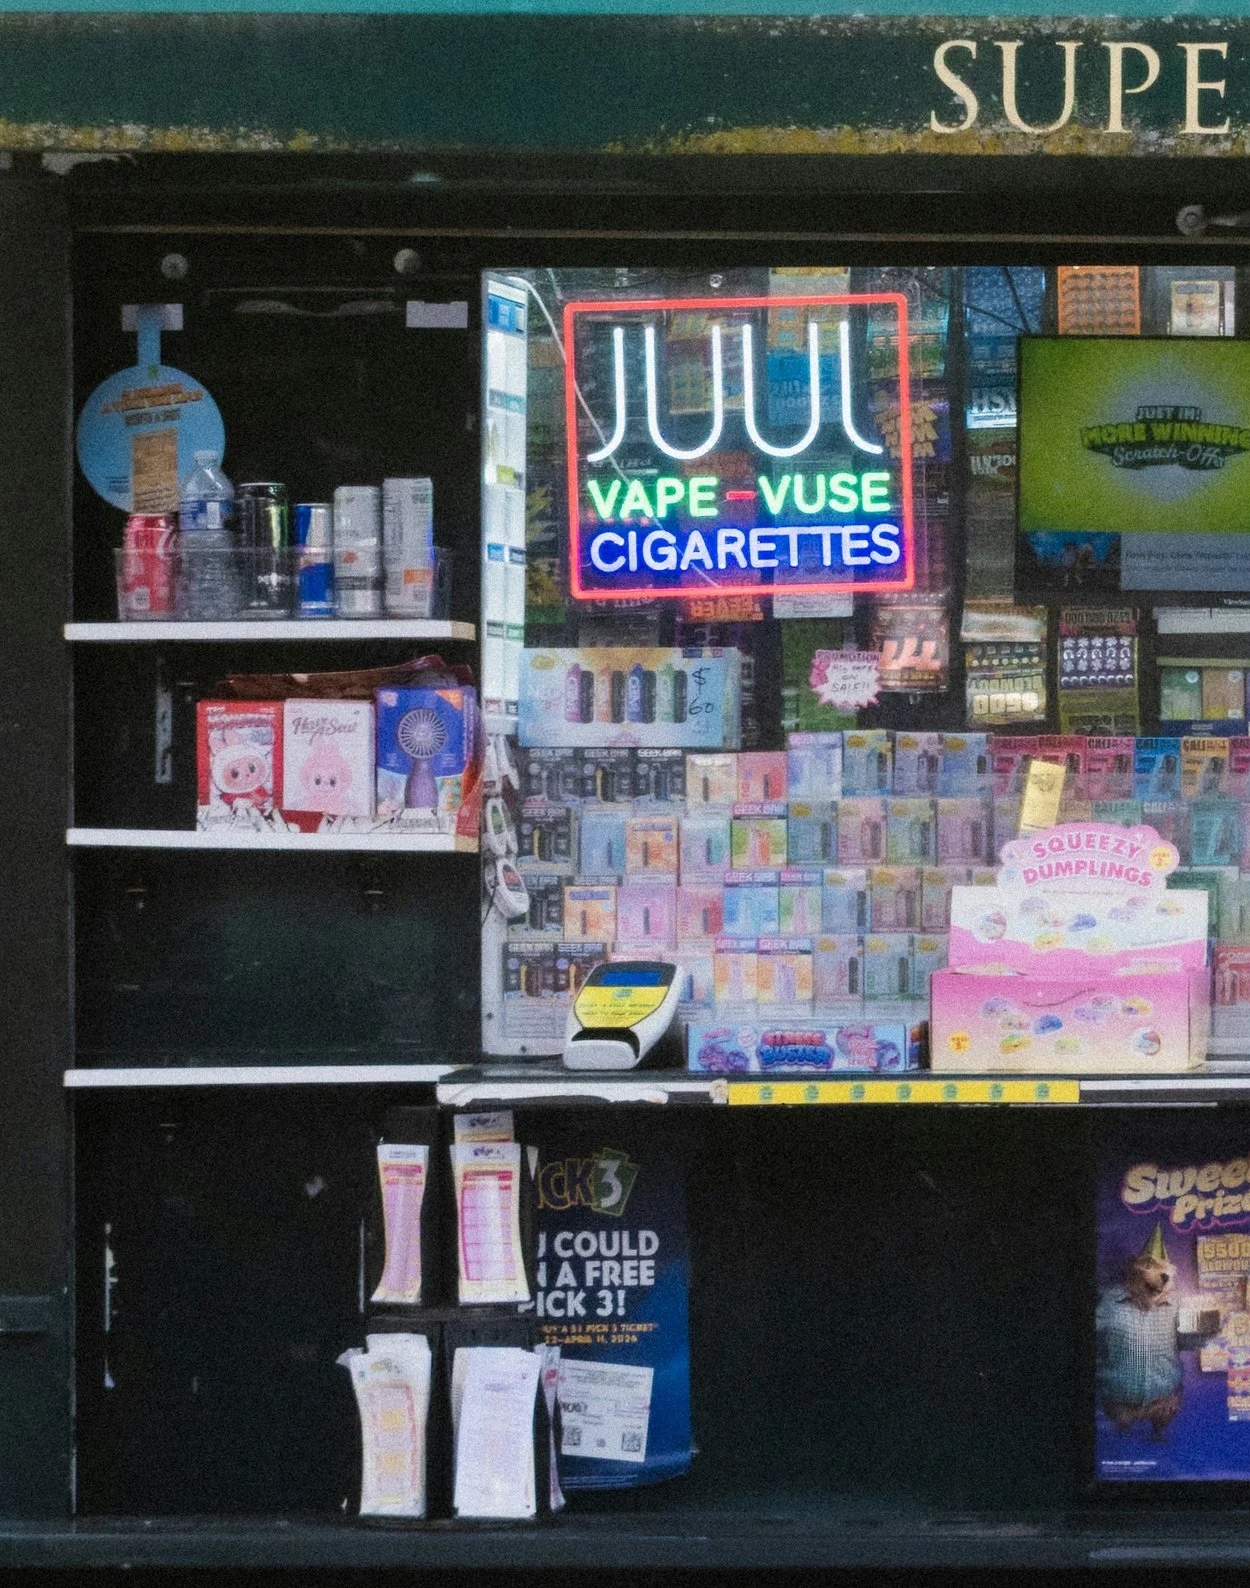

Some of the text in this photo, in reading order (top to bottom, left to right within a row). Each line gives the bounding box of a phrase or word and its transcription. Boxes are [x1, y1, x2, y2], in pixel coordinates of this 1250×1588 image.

[587, 320, 884, 462] JUUL
[588, 471, 892, 520] VAPE VUSE
[589, 523, 901, 573] CIGARETTES
[1033, 833, 1142, 860] SQUEEZY
[1023, 860, 1153, 888] DUMPLINGS
[554, 1230, 660, 1258] COULD
[555, 1260, 578, 1288] A
[585, 1259, 656, 1287] FREE
[536, 1288, 627, 1318] ICK 3!
